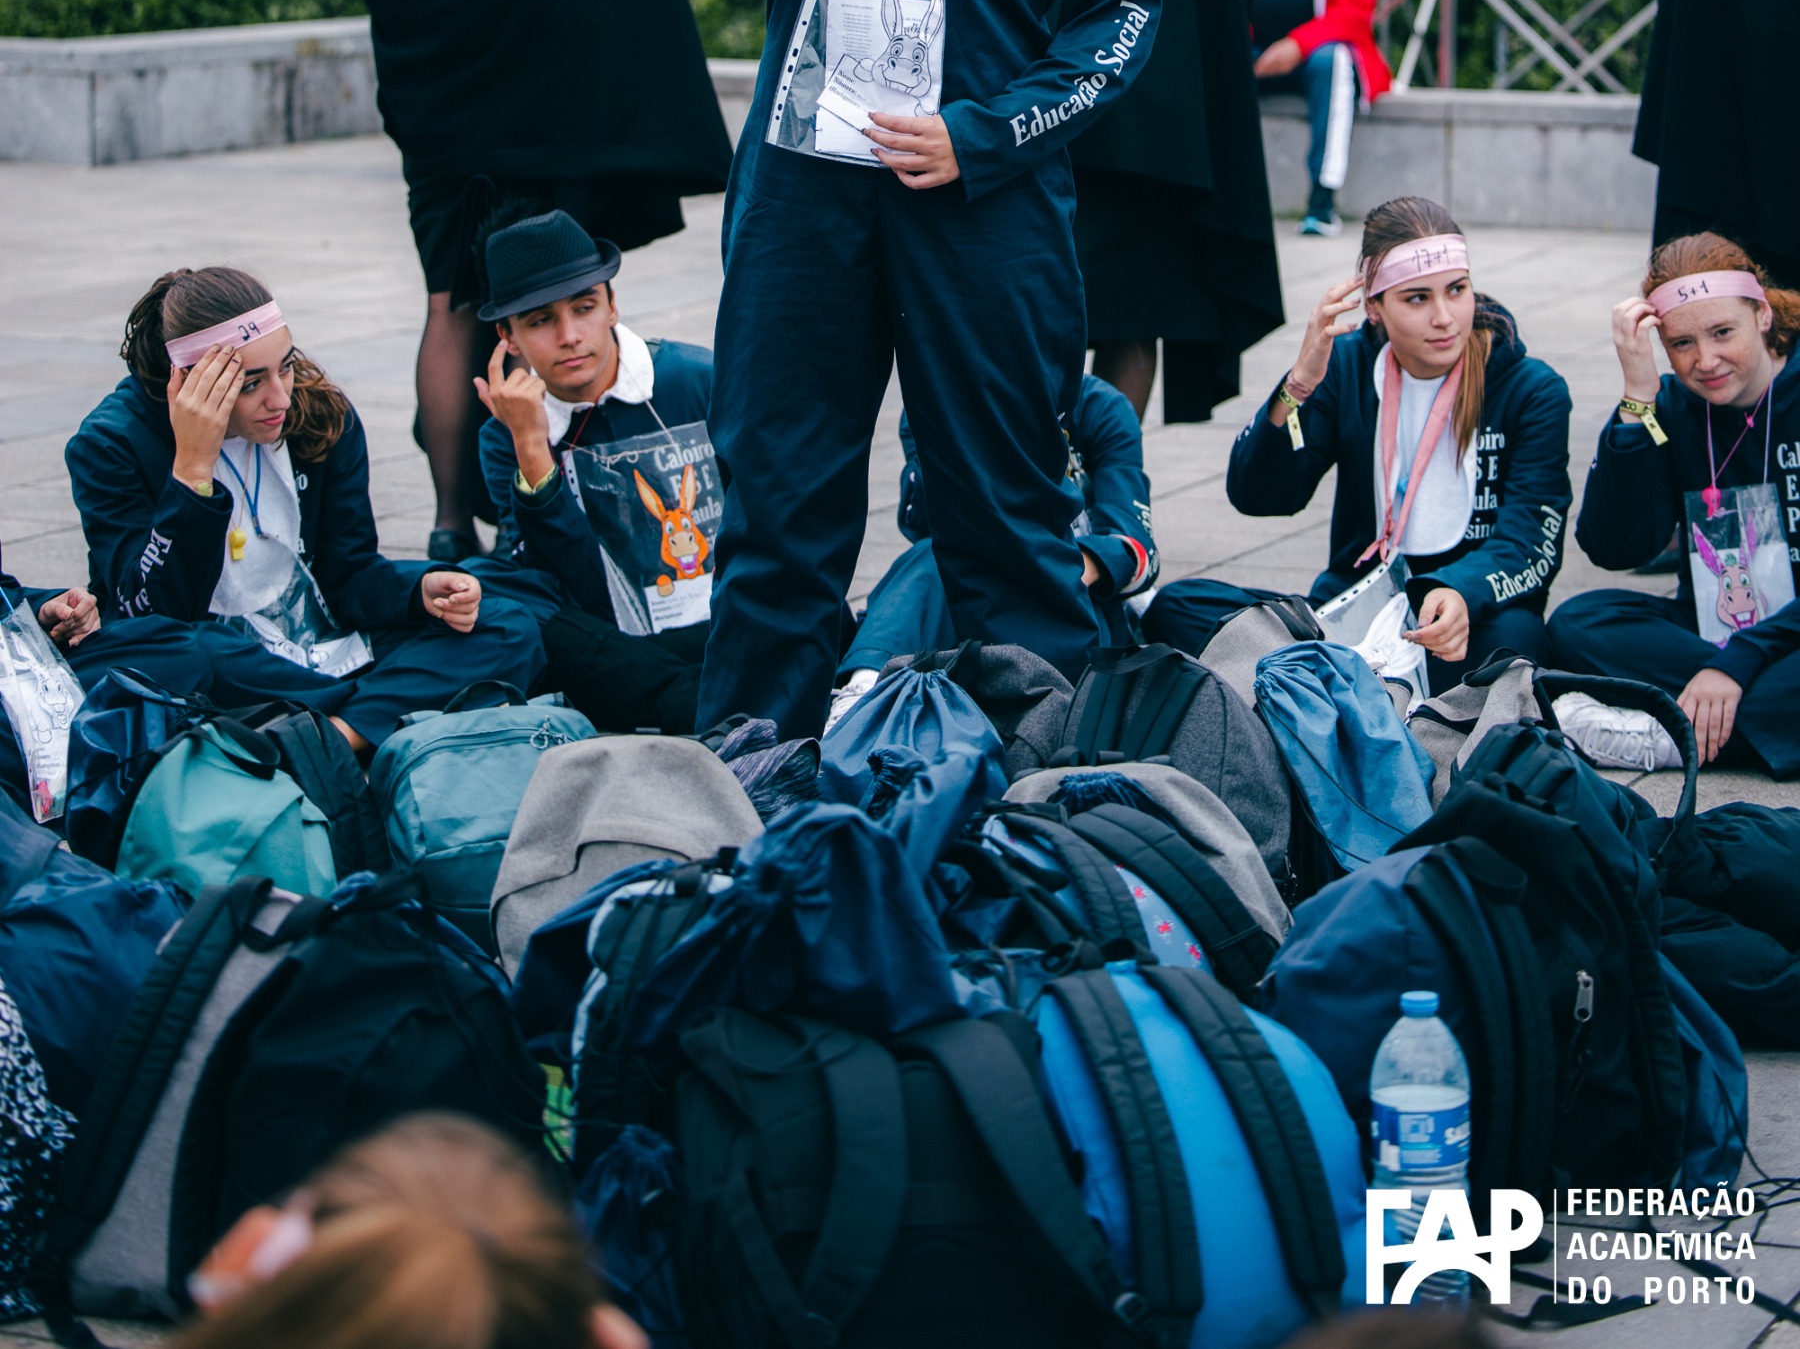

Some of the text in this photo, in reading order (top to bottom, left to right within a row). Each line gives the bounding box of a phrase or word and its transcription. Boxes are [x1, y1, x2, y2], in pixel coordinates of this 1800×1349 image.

[1009, 0, 1150, 147] Educação Social
[1677, 280, 1709, 303] 5+1
[1477, 426, 1505, 450] oiro
[654, 439, 716, 472] Caloiro
[691, 496, 722, 526] aula
[1473, 487, 1498, 510] ula
